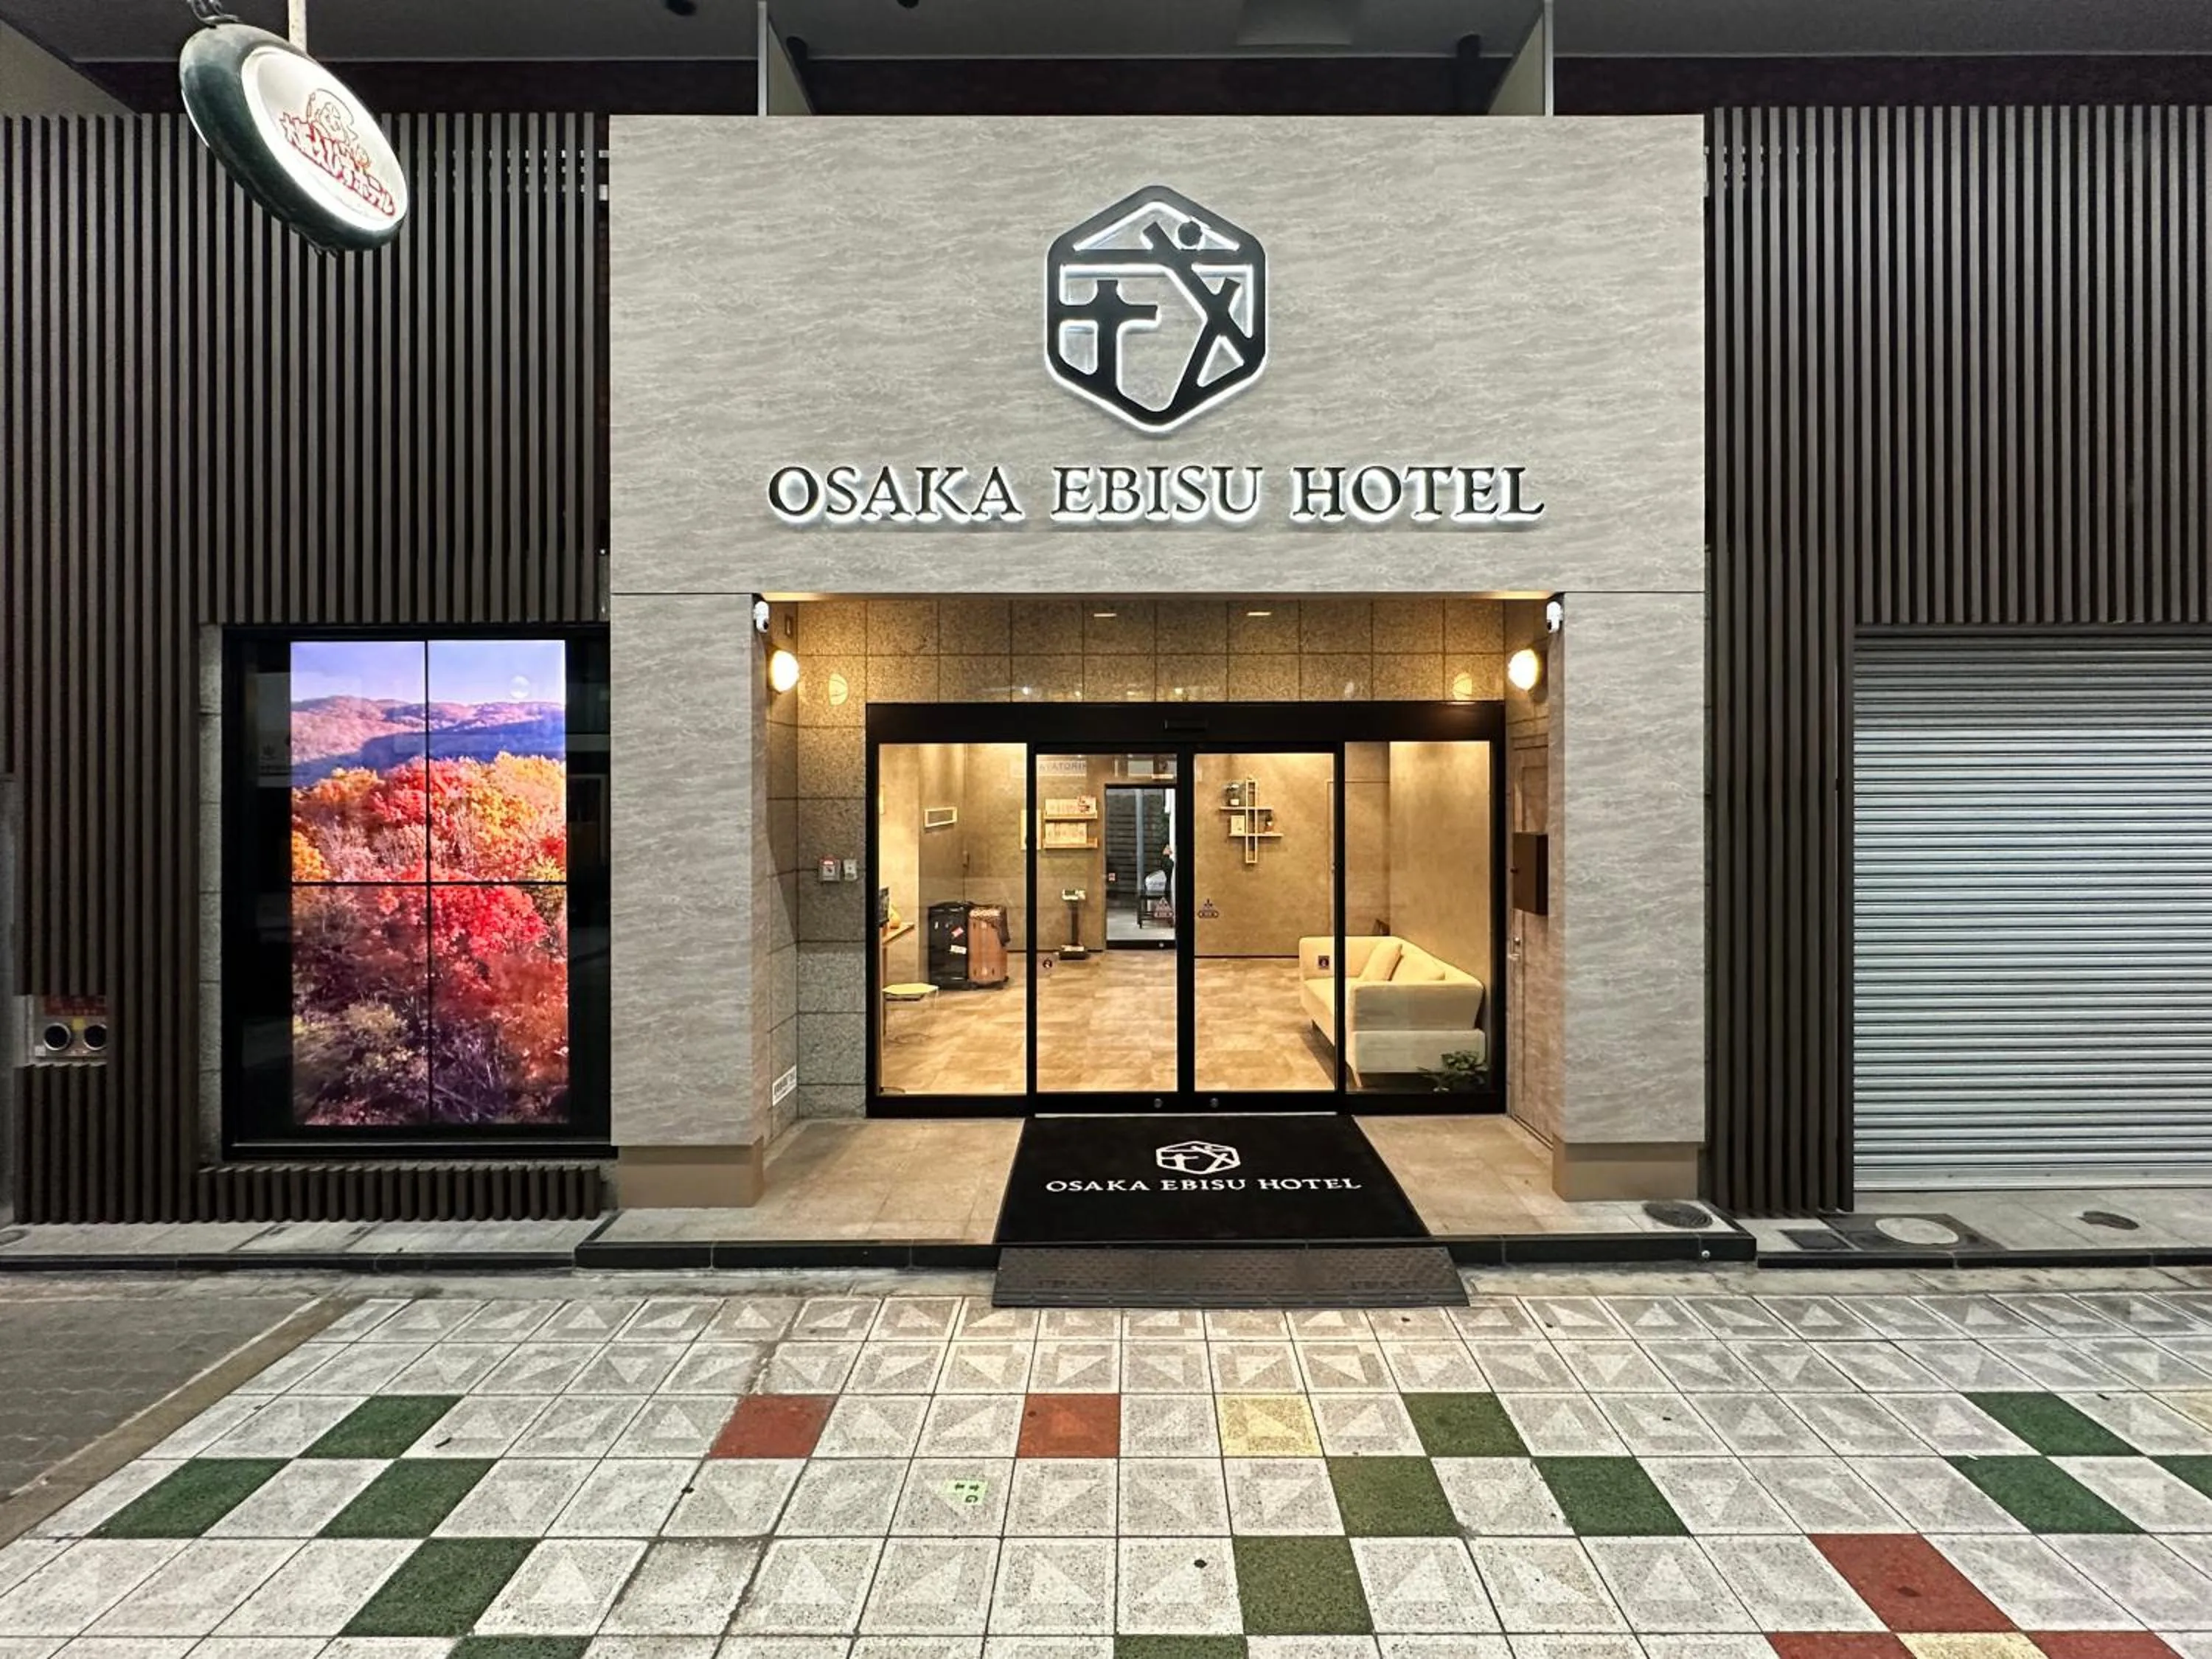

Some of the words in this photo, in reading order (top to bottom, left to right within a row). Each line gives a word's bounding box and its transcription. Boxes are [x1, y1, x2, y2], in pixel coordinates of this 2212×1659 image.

[768, 465, 1023, 519] OSAKA
[1051, 465, 1264, 519] EBISU
[1291, 465, 1545, 519] HOTEL
[1045, 1180, 1150, 1192] OSAKA
[1160, 1179, 1246, 1191] EBISU
[1258, 1178, 1362, 1190] HOTEL
